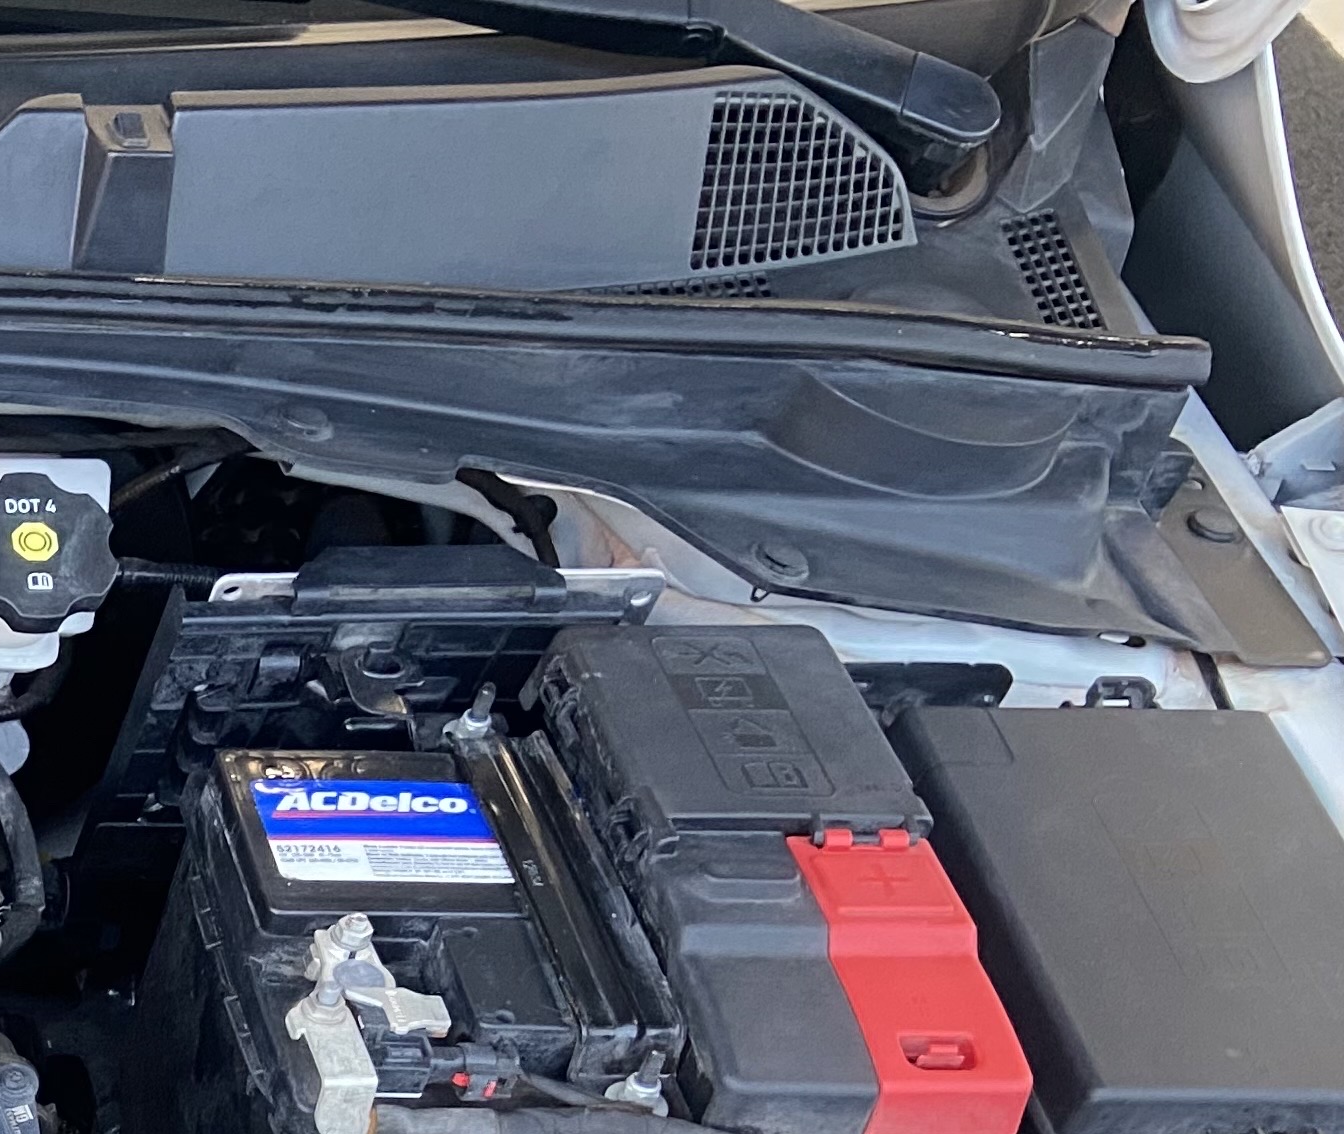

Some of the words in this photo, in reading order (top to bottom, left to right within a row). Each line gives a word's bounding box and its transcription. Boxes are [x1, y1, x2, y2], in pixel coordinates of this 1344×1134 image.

[4, 498, 41, 514] DOT
[45, 498, 57, 513] 4
[275, 791, 468, 813] ACDelco
